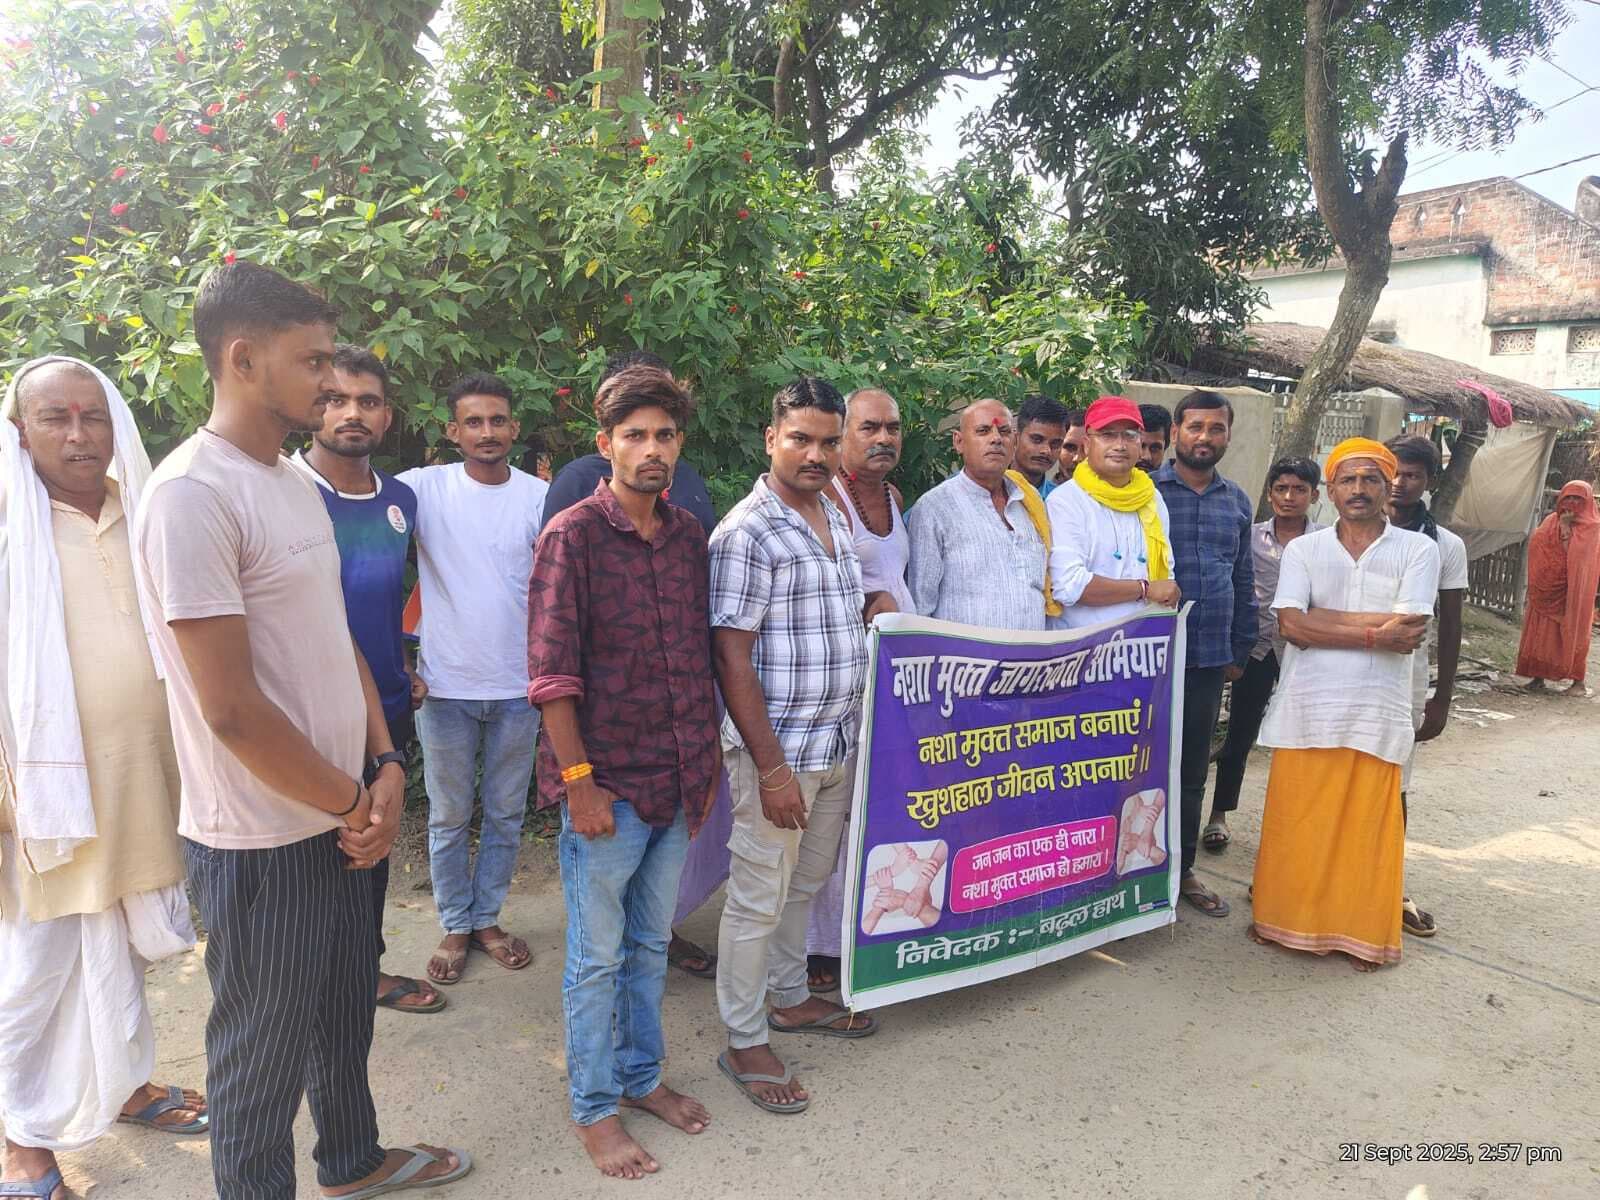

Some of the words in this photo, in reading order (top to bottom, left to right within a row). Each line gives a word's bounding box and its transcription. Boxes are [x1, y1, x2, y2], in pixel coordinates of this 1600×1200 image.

[891, 656, 935, 705] नशा
[937, 656, 1000, 718] मुक्त
[1085, 629, 1170, 683] अभियान
[918, 732, 957, 765] नशा
[960, 725, 1012, 767] मुक्त
[1015, 714, 1076, 749] समाज
[1080, 698, 1141, 737] बनाएं
[906, 776, 995, 829] खुशहाल
[997, 763, 1055, 798] जीवन
[1060, 744, 1138, 788] अपनाएं
[963, 880, 989, 899] नशा
[991, 872, 1018, 900] मुक्त
[1018, 862, 1056, 886] समाज
[1056, 855, 1071, 877] हो
[972, 851, 992, 871] जन
[992, 845, 1012, 864] जन
[1013, 841, 1031, 859] का
[1031, 836, 1053, 856] एक
[1055, 828, 1070, 850] ही
[1070, 828, 1097, 846] नारा
[896, 936, 1004, 969] निवेदक
[1093, 890, 1127, 919] हाथ
